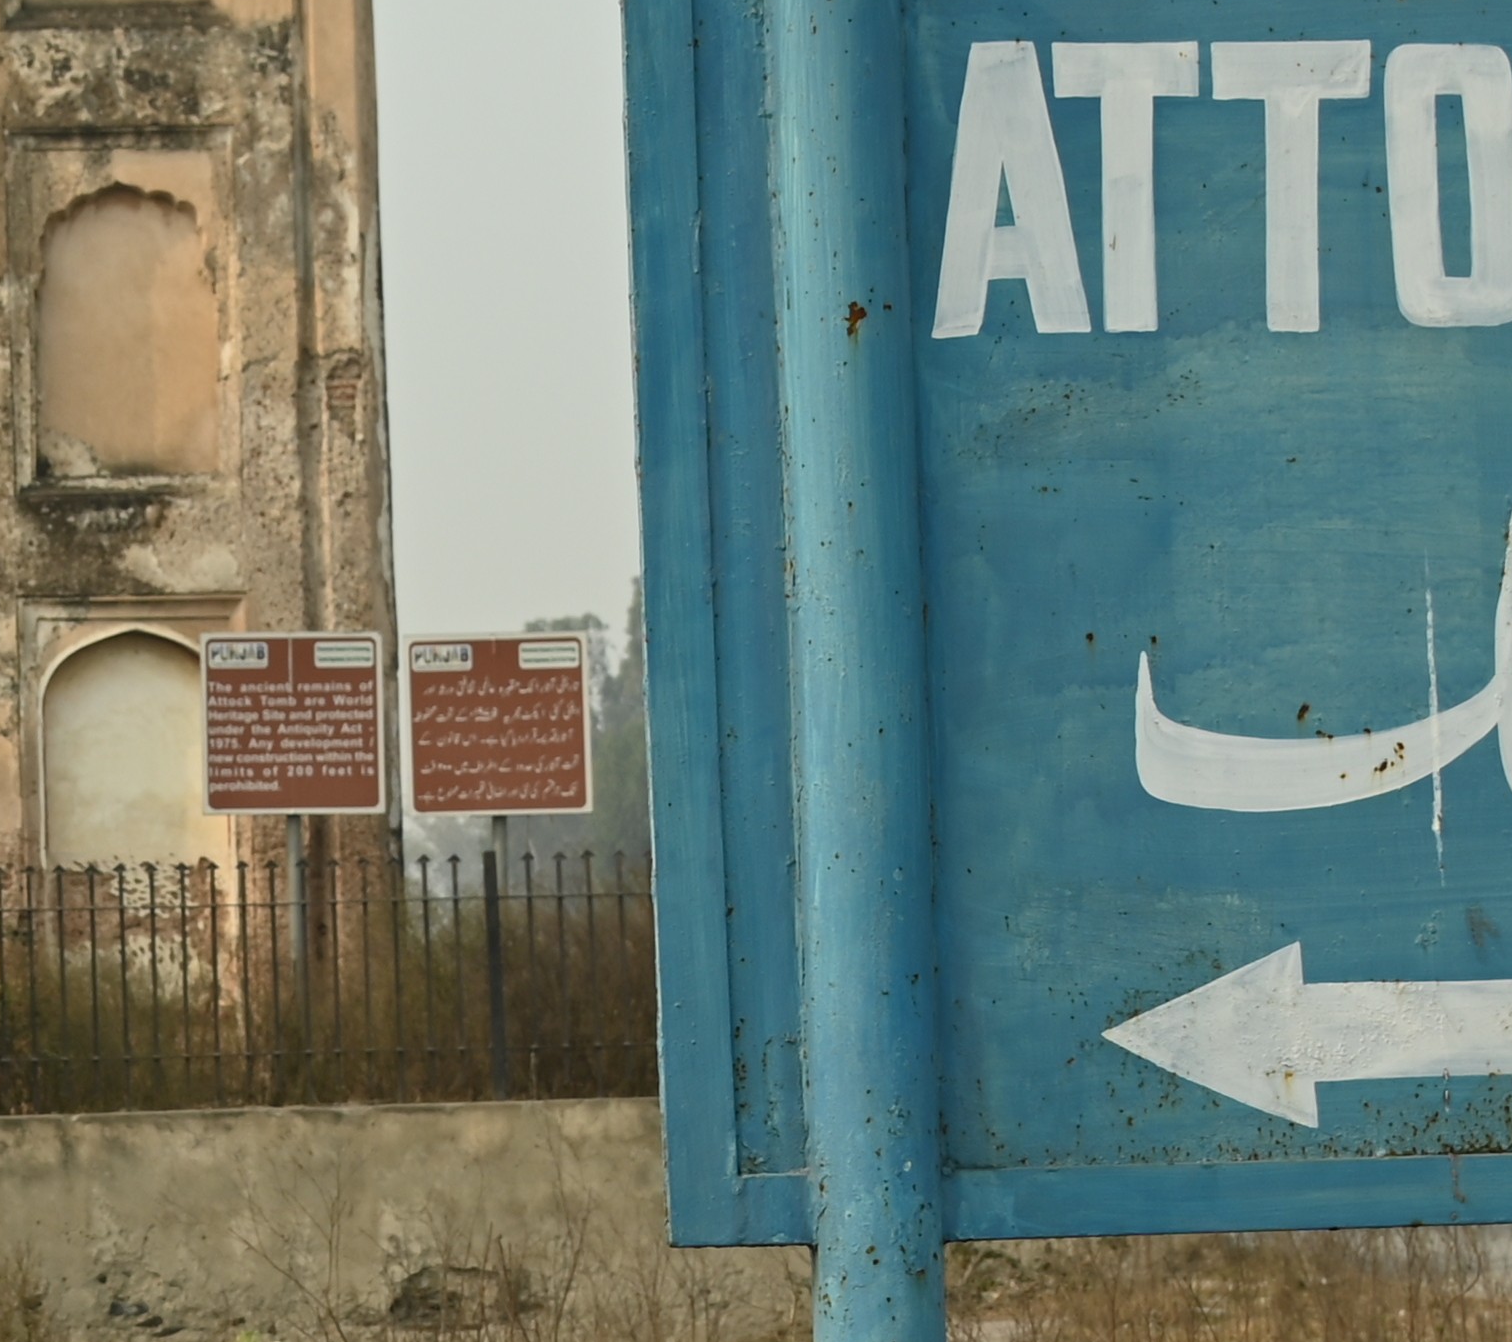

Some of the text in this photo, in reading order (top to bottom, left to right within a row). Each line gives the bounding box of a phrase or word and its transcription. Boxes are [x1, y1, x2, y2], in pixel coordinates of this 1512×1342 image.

[211, 644, 266, 660] PUNJAB
[414, 647, 469, 664] PUNJAB
[208, 680, 374, 692] The ancient remains of
[208, 695, 373, 707] Attock Tomb are World
[208, 709, 373, 723] Heritage Site and protected
[209, 725, 244, 734] under
[251, 724, 271, 734] the
[277, 724, 334, 736] Antiquity
[341, 723, 362, 733] Act
[249, 738, 274, 750] Any
[280, 737, 363, 750] development
[209, 751, 374, 762] new construction within the
[209, 765, 374, 776] limits of 200 feet is
